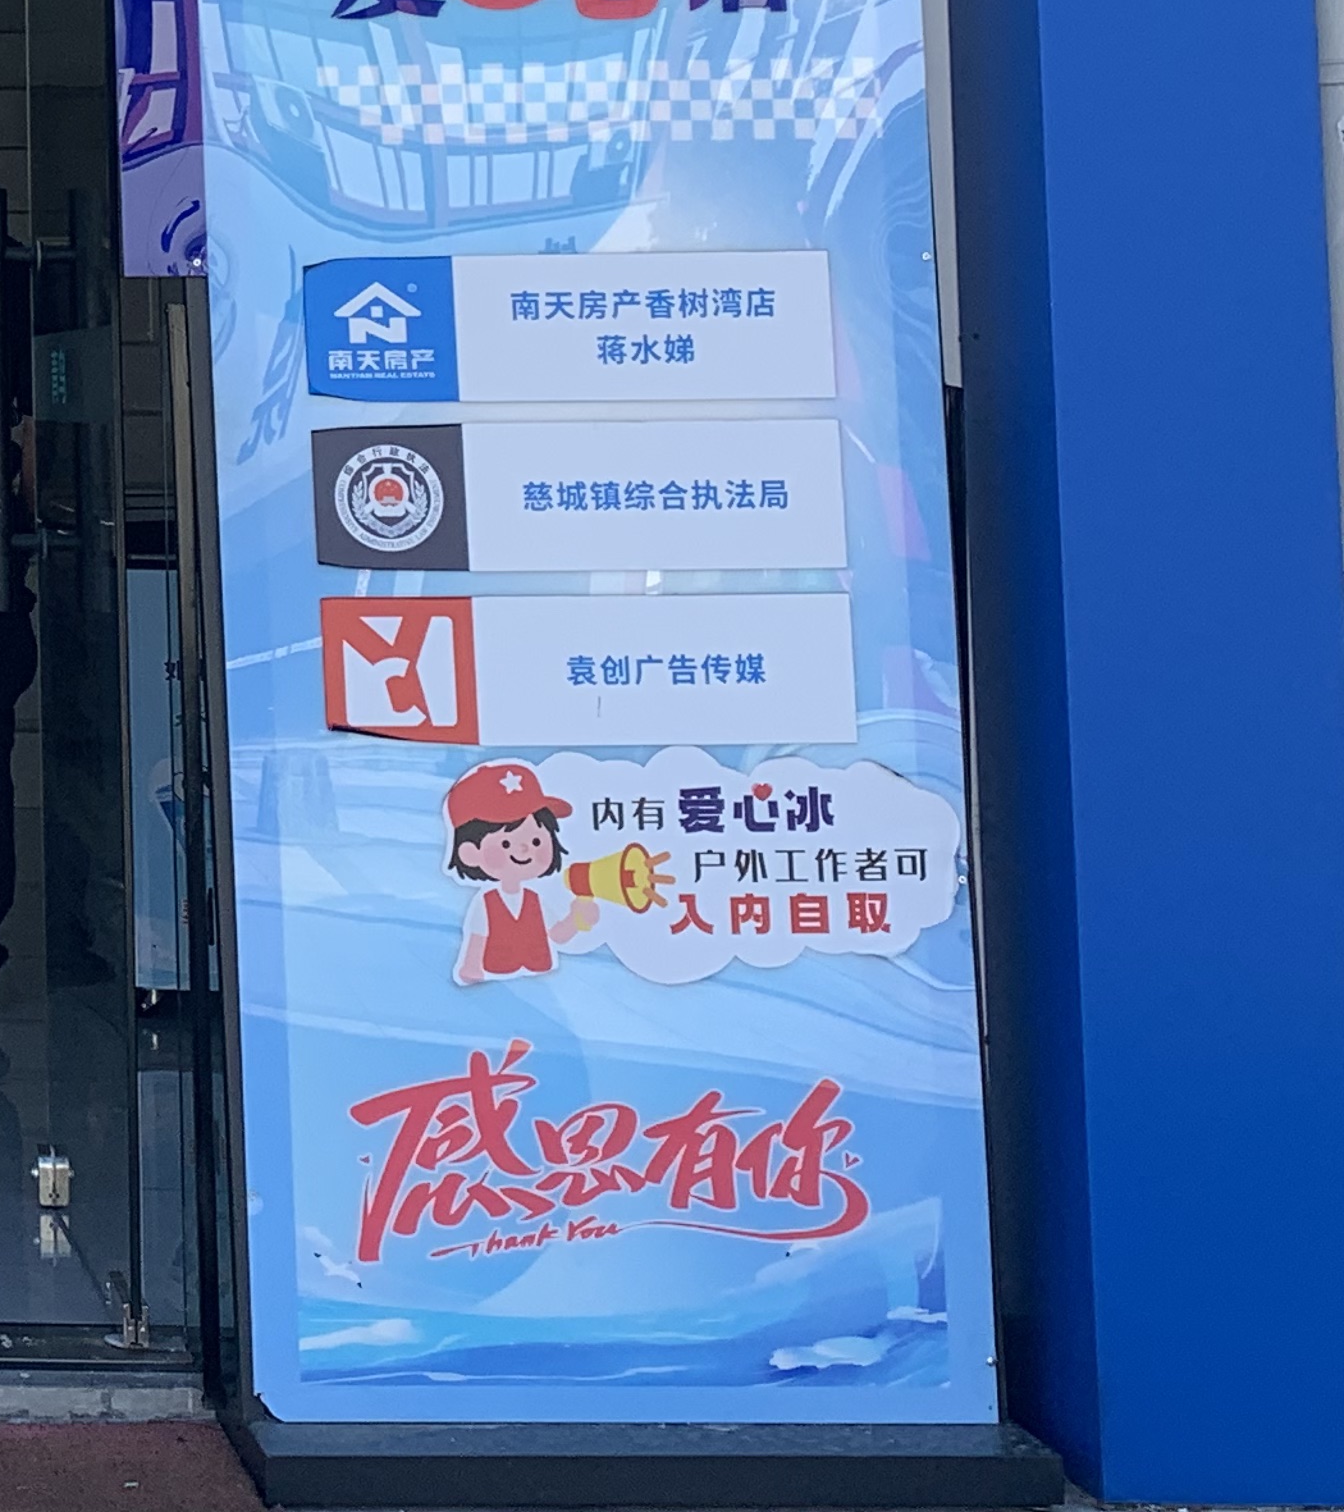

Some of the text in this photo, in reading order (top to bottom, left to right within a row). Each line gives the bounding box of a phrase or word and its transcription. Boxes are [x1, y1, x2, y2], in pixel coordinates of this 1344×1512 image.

[510, 287, 777, 322] 南天房产香树湾店
[328, 349, 435, 371] 南天房产
[596, 334, 696, 366] 蒋水娣
[522, 480, 789, 513] 慈城镇综合执法局
[566, 654, 768, 687] 袁创广告传媒
[693, 847, 929, 883] 户外工作者可
[669, 891, 892, 935] 入内自取
[350, 1040, 870, 1262] 感恩有你
